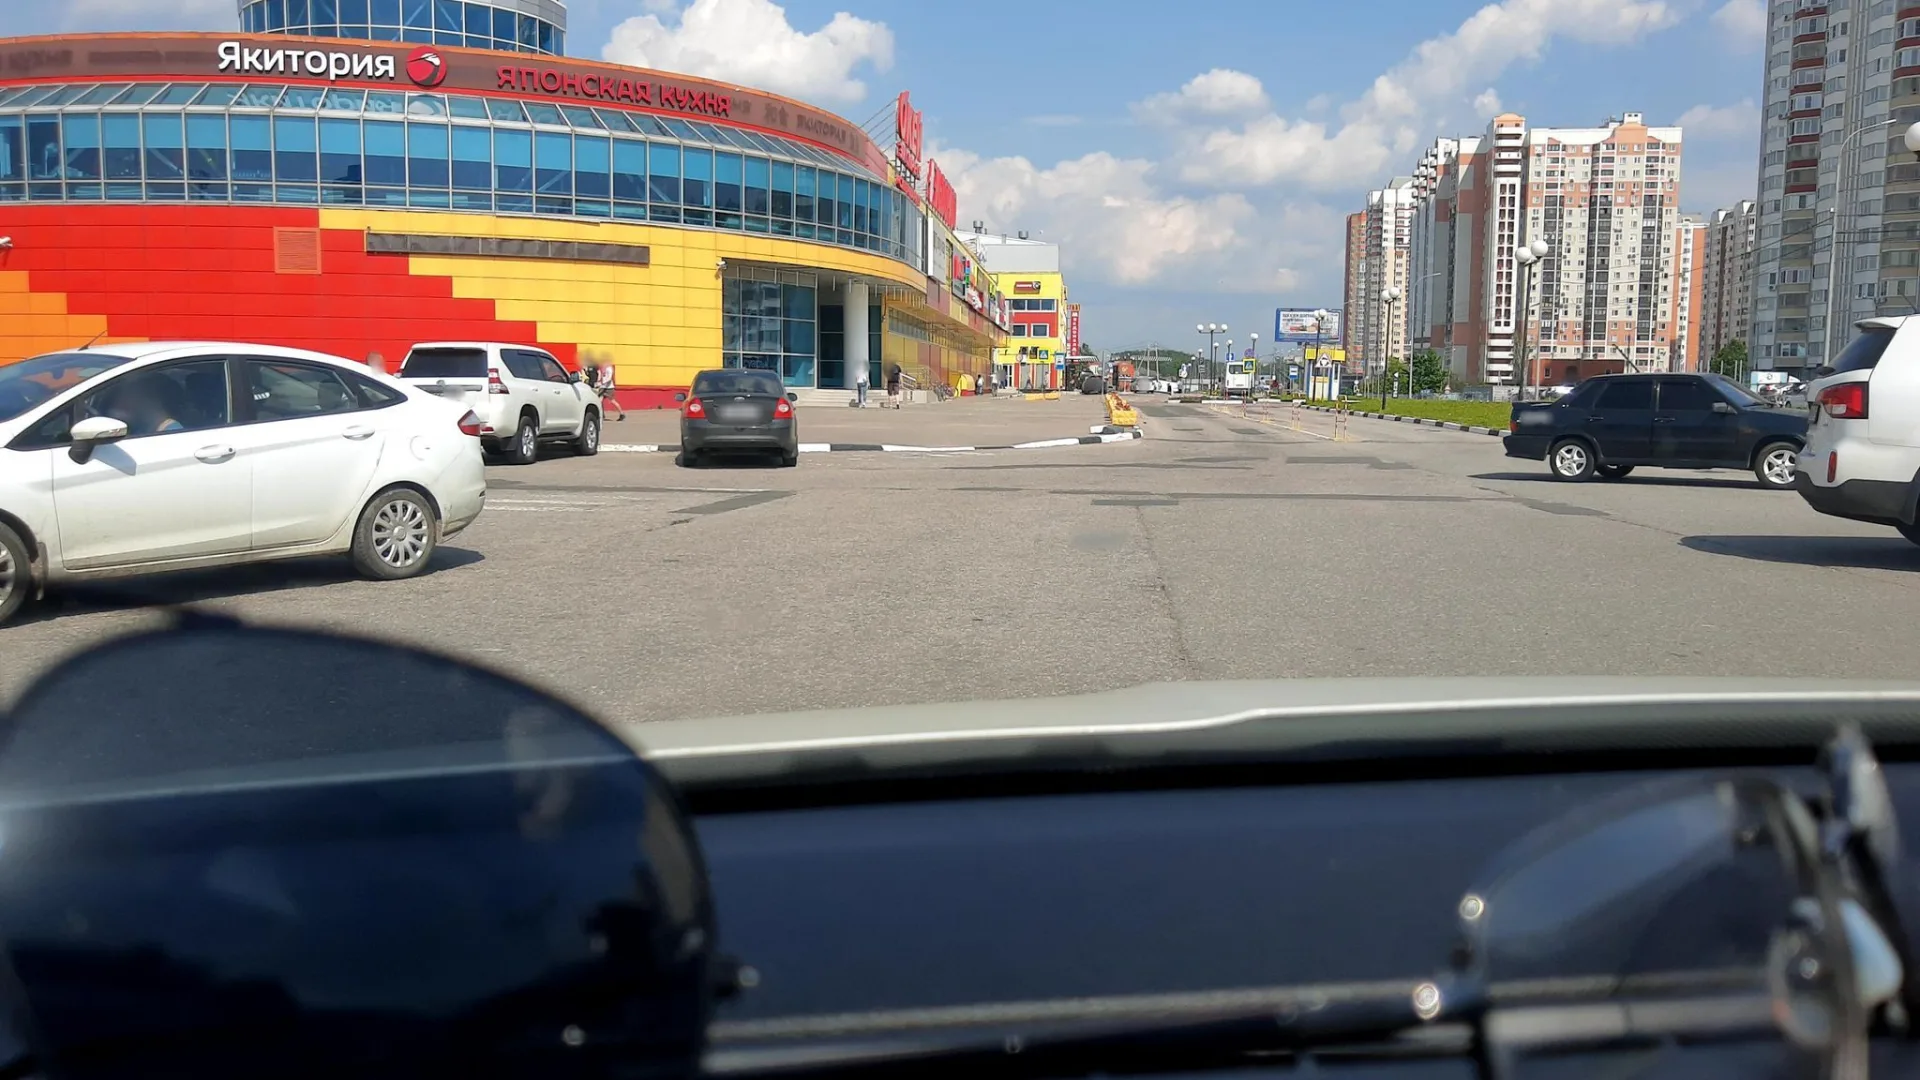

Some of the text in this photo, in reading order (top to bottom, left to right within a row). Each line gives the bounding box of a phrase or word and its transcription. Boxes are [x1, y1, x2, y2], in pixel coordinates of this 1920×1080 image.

[217, 41, 396, 79] Якитория
[497, 64, 652, 104] ЯПОНСКАЯ
[658, 85, 732, 117] КУХНЯ
